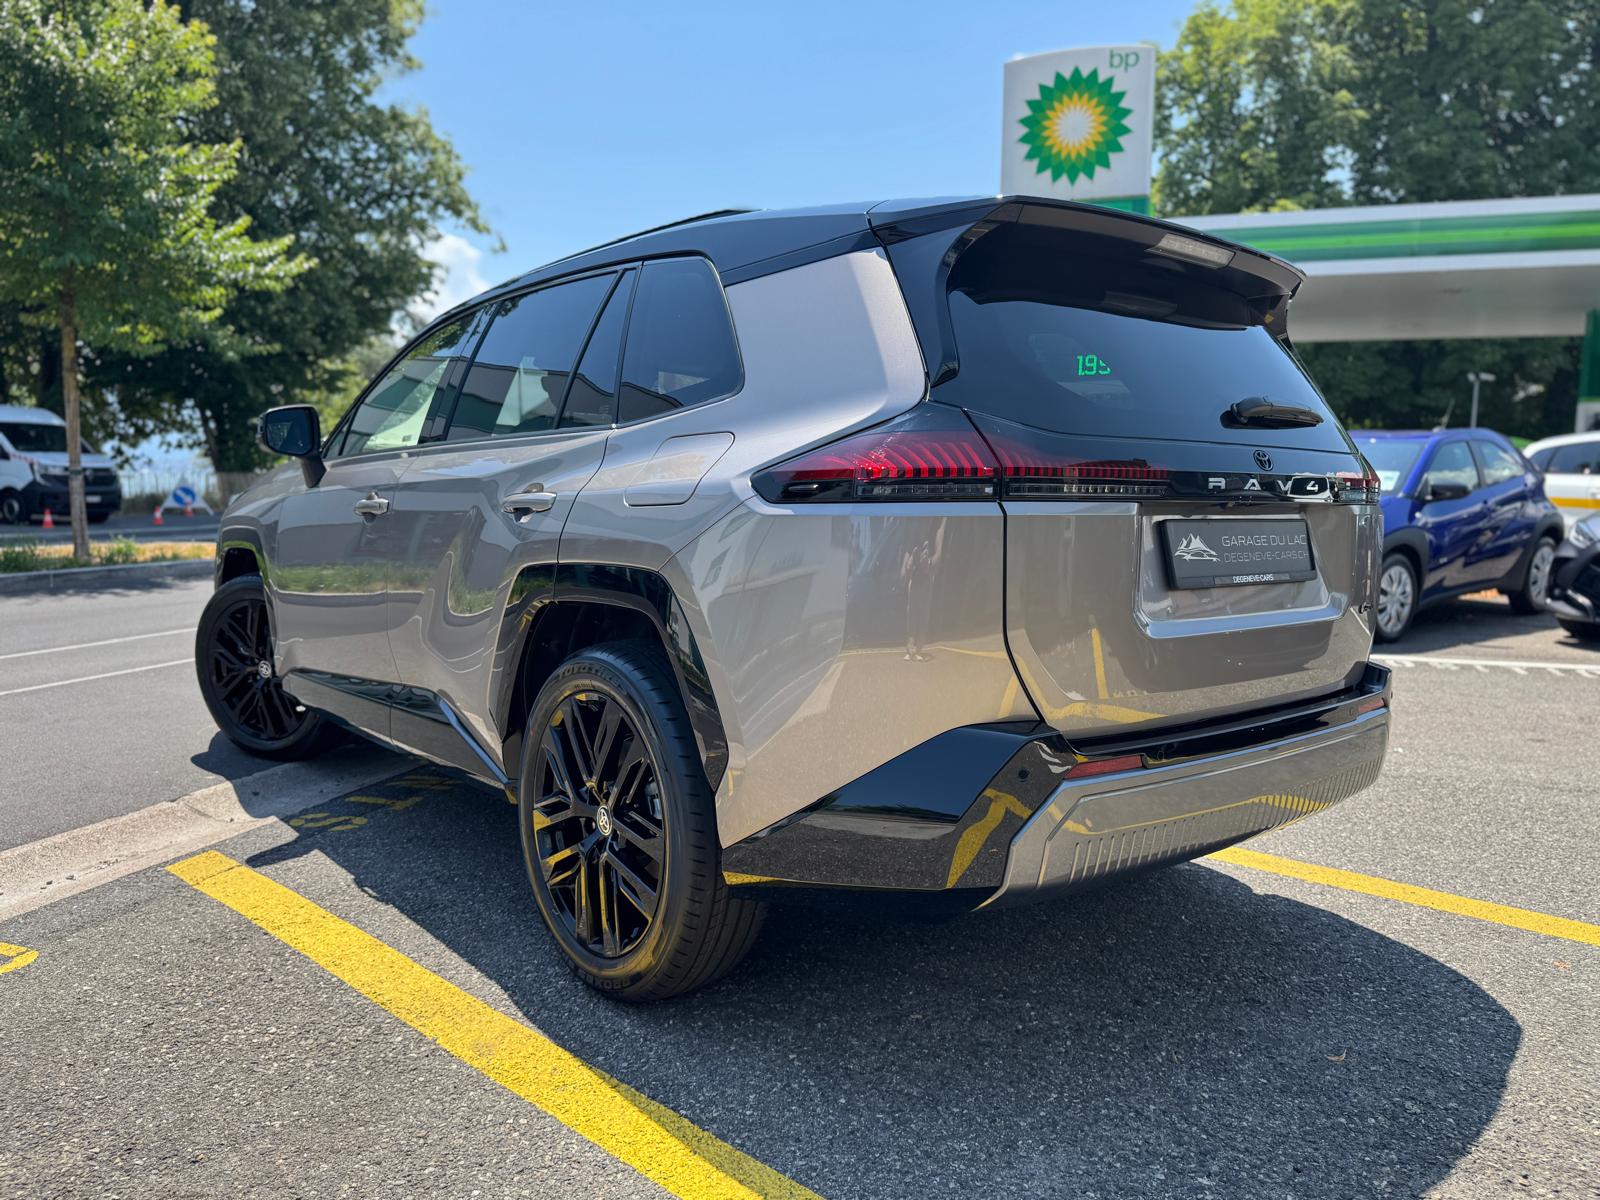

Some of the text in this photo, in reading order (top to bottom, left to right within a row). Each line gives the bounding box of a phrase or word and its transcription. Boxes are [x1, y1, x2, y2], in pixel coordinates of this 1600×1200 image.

[1109, 50, 1140, 72] bp
[1208, 477, 1318, 493] RAV4
[1221, 534, 1307, 547] GARAGE DU LAC
